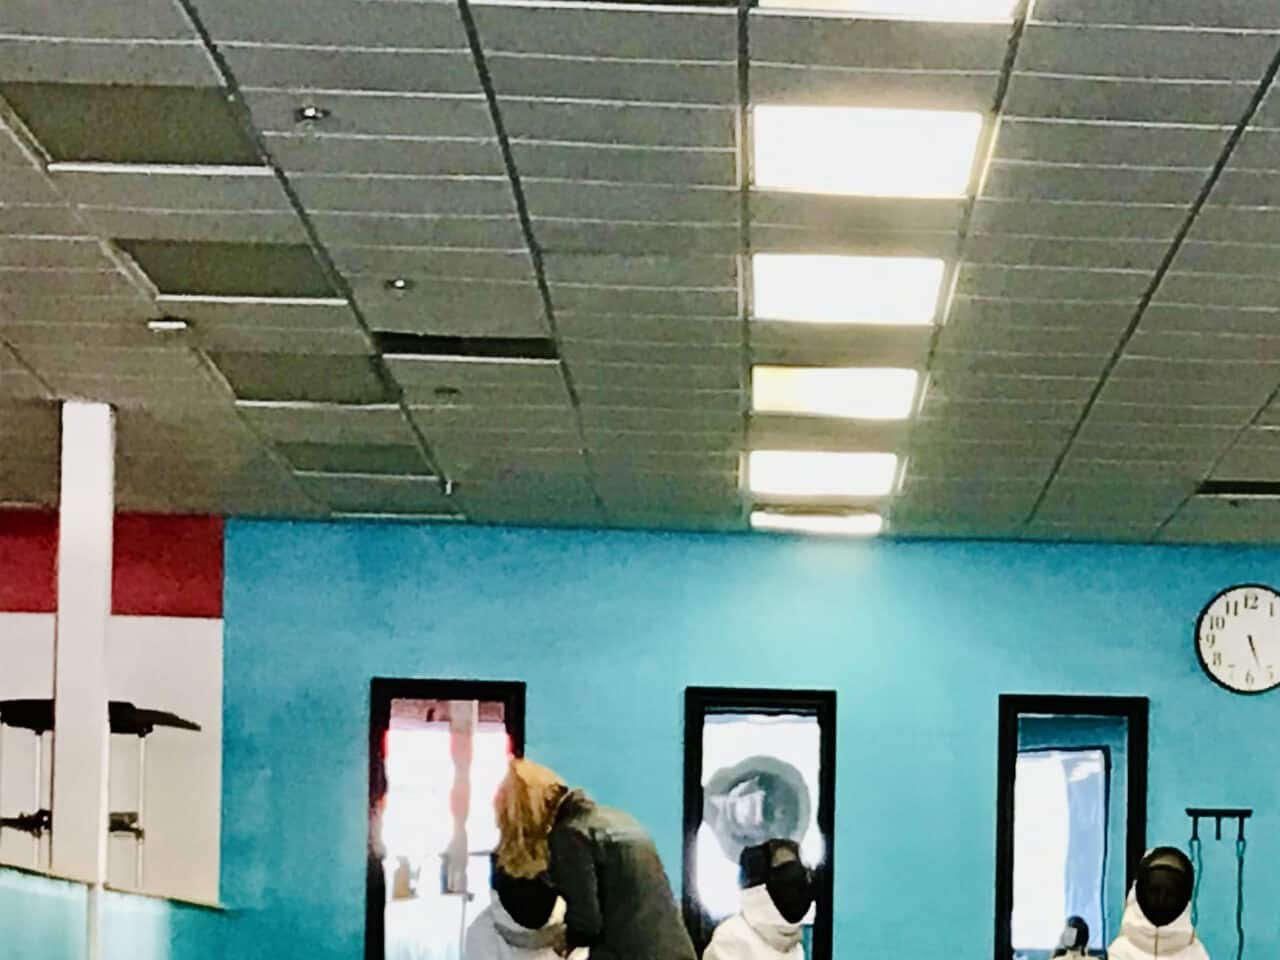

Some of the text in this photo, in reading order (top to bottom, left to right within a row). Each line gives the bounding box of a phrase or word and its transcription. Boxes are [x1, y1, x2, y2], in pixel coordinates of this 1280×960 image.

[1225, 600, 1239, 616] 11
[1243, 593, 1259, 610] 12
[1268, 601, 1275, 617] 1
[1209, 615, 1226, 631] 10
[1206, 633, 1216, 649] 9
[1244, 668, 1255, 685] 6
